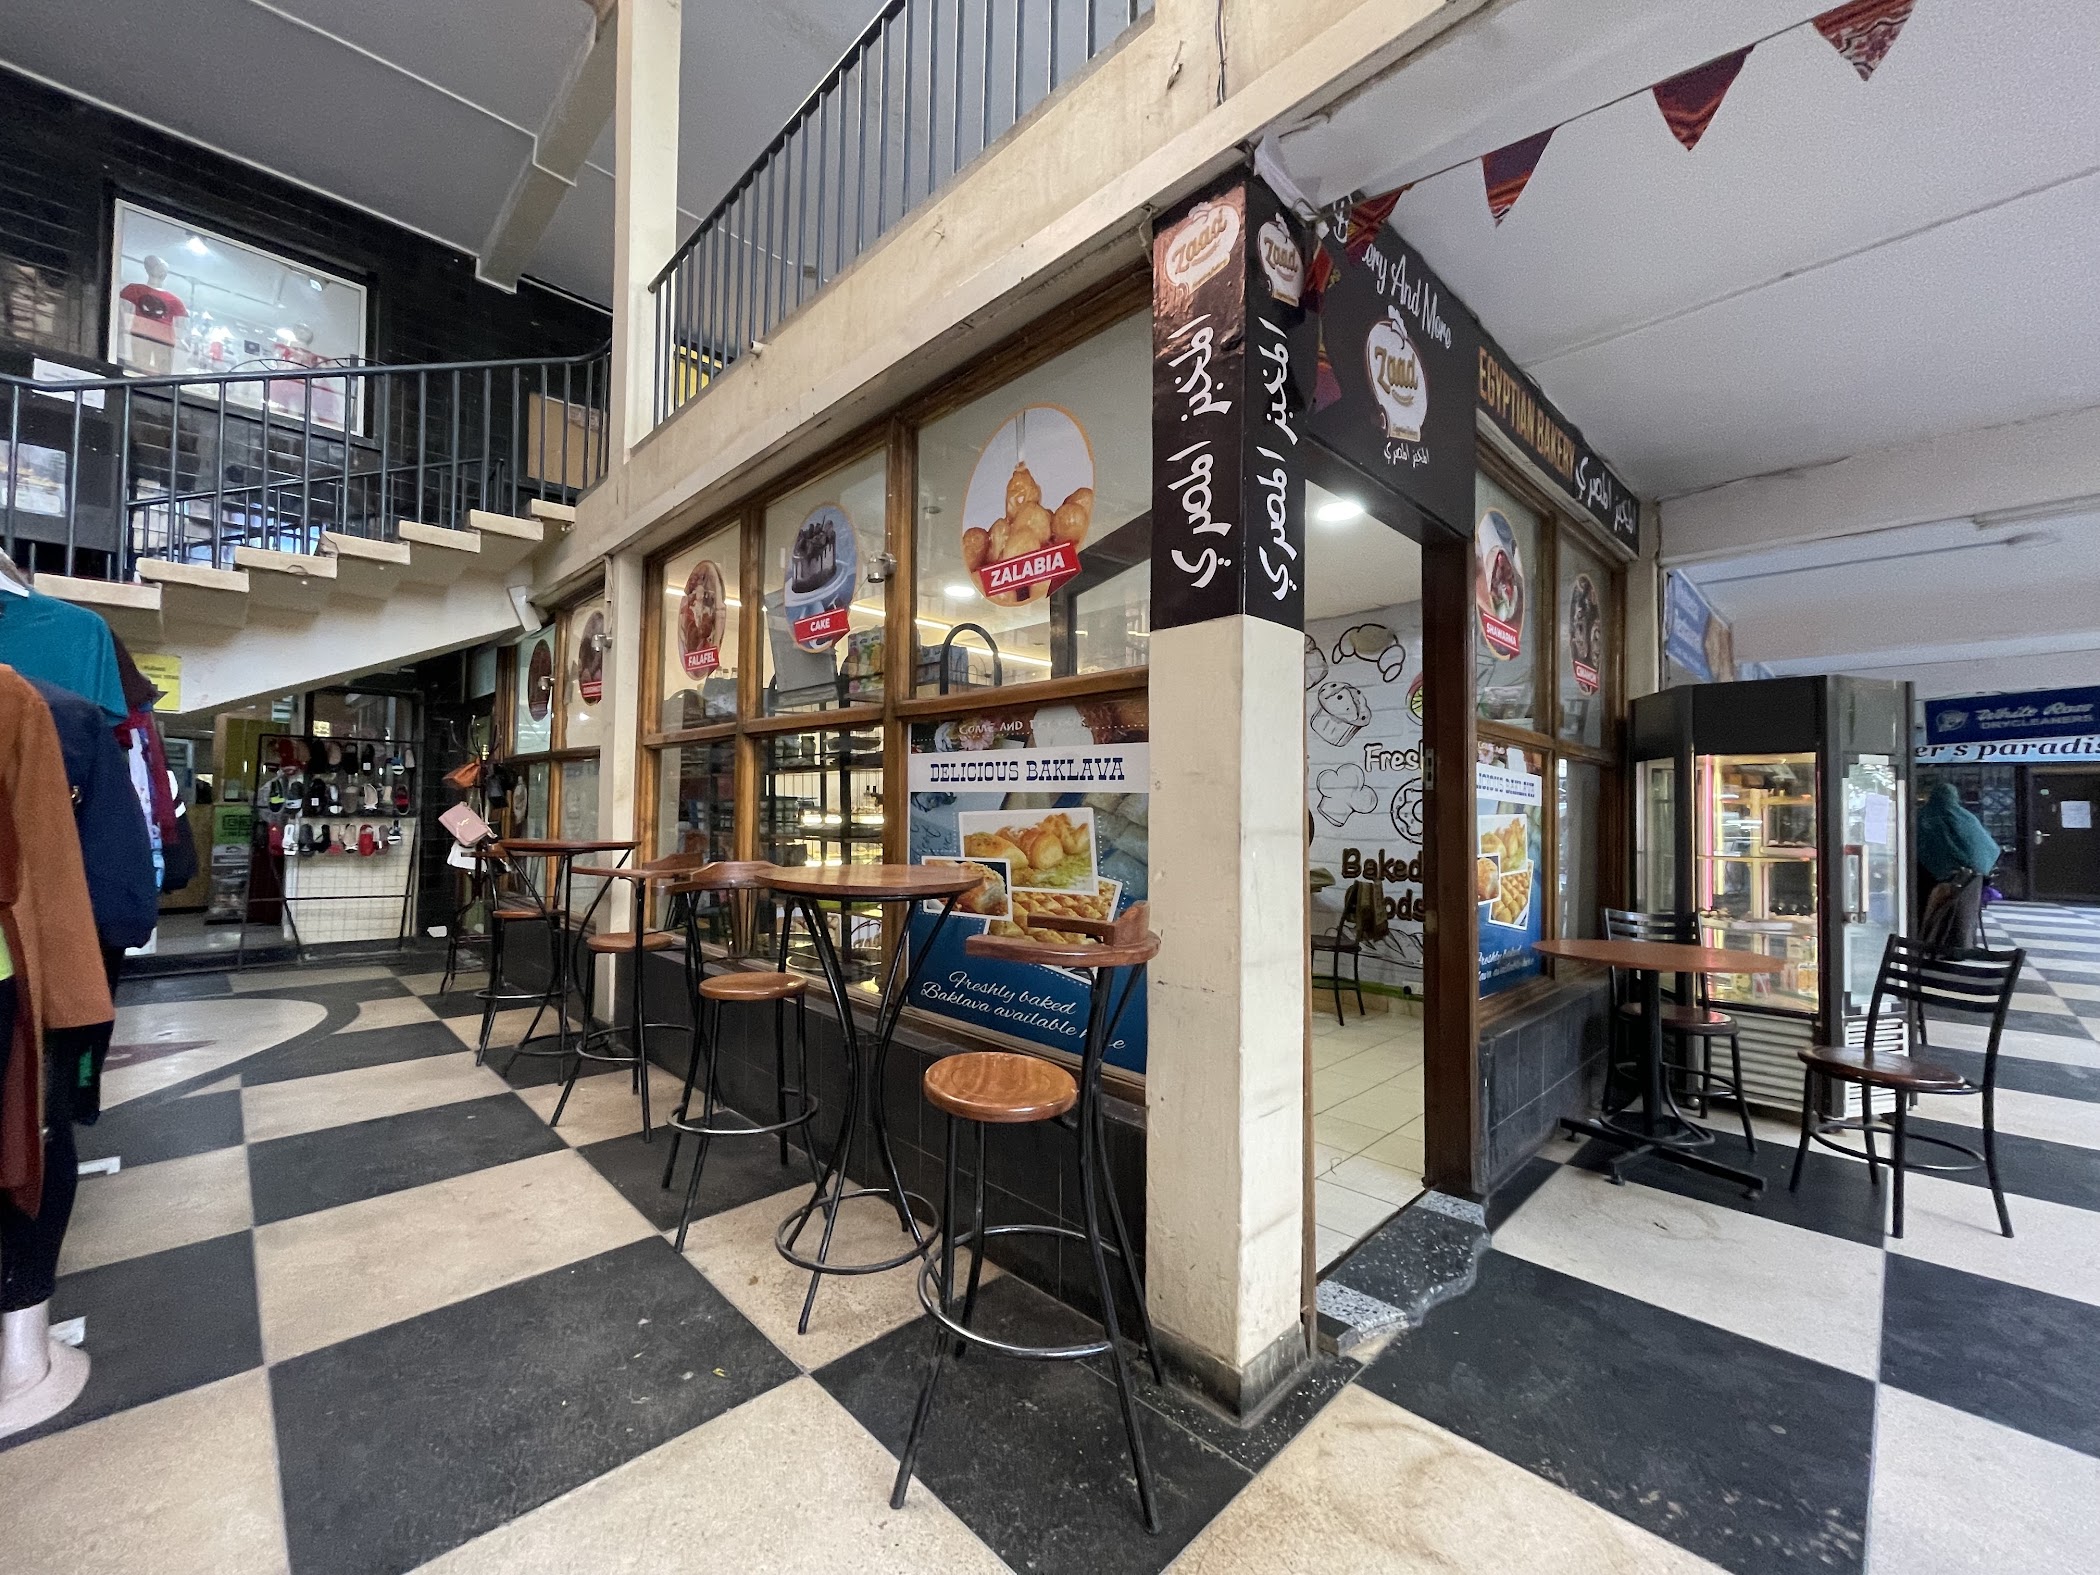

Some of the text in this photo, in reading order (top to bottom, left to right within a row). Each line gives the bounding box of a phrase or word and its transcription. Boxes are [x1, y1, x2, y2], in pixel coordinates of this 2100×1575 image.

[1264, 236, 1298, 273] Zaad
[1391, 254, 1421, 317] And
[1422, 282, 1451, 349] More
[1375, 345, 1418, 394] Zaad
[1479, 346, 1575, 482] EGYPTIAN BAKERY
[991, 551, 1065, 588] ZALABIA
[810, 618, 831, 632] CAKE
[688, 651, 716, 667] FALAFEL
[959, 722, 994, 735] COME
[1000, 721, 1023, 732] AND
[930, 757, 1125, 782] DELICIOUS BAKLAVA
[1341, 848, 1423, 883] Baked
[920, 981, 990, 1013] Baklava
[993, 1006, 1077, 1037] available
[949, 970, 1076, 1015] Freshly baked
